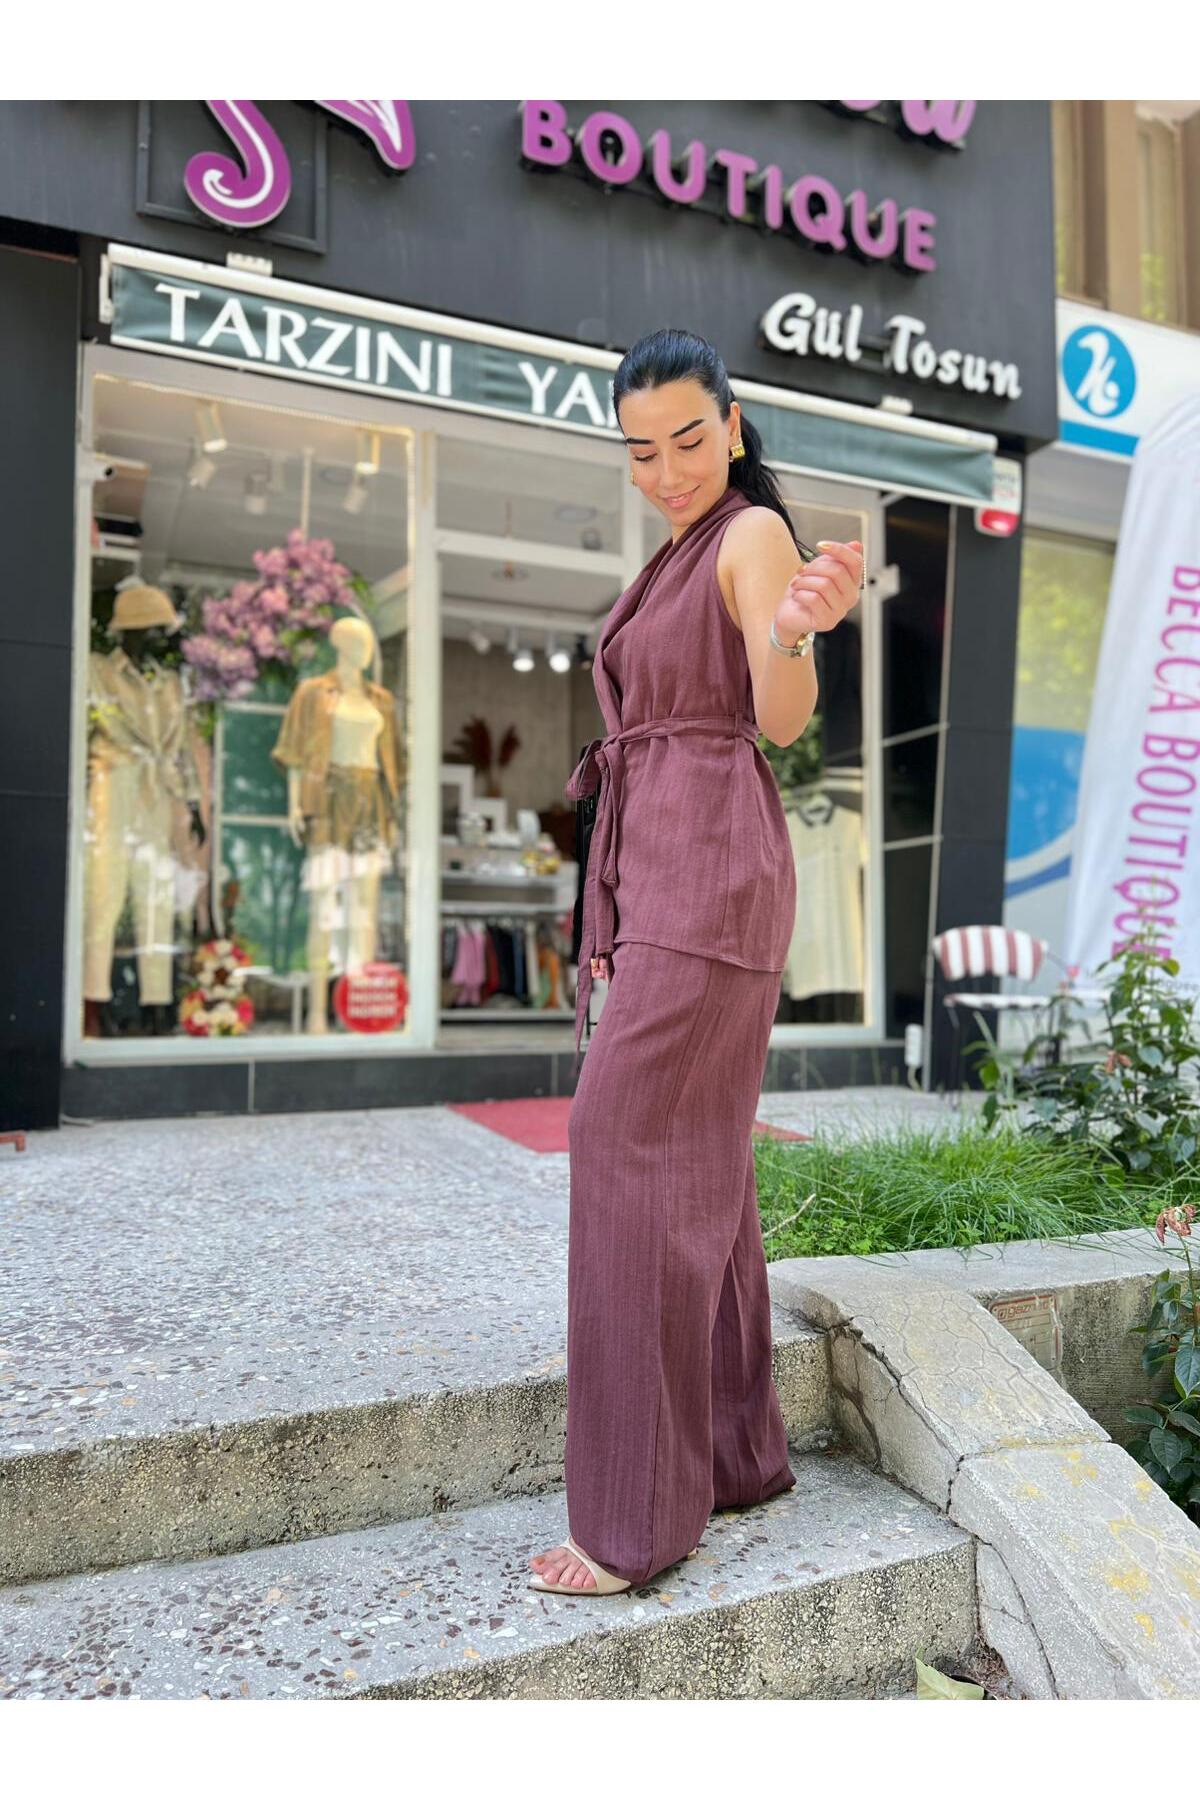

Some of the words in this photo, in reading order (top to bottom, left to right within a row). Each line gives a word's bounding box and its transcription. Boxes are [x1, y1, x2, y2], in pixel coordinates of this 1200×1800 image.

[521, 100, 937, 272] BOUTIQUE
[155, 282, 454, 397] TARZINI
[518, 361, 618, 429] YA
[763, 292, 863, 361] Gül
[886, 315, 1022, 400] Tosun
